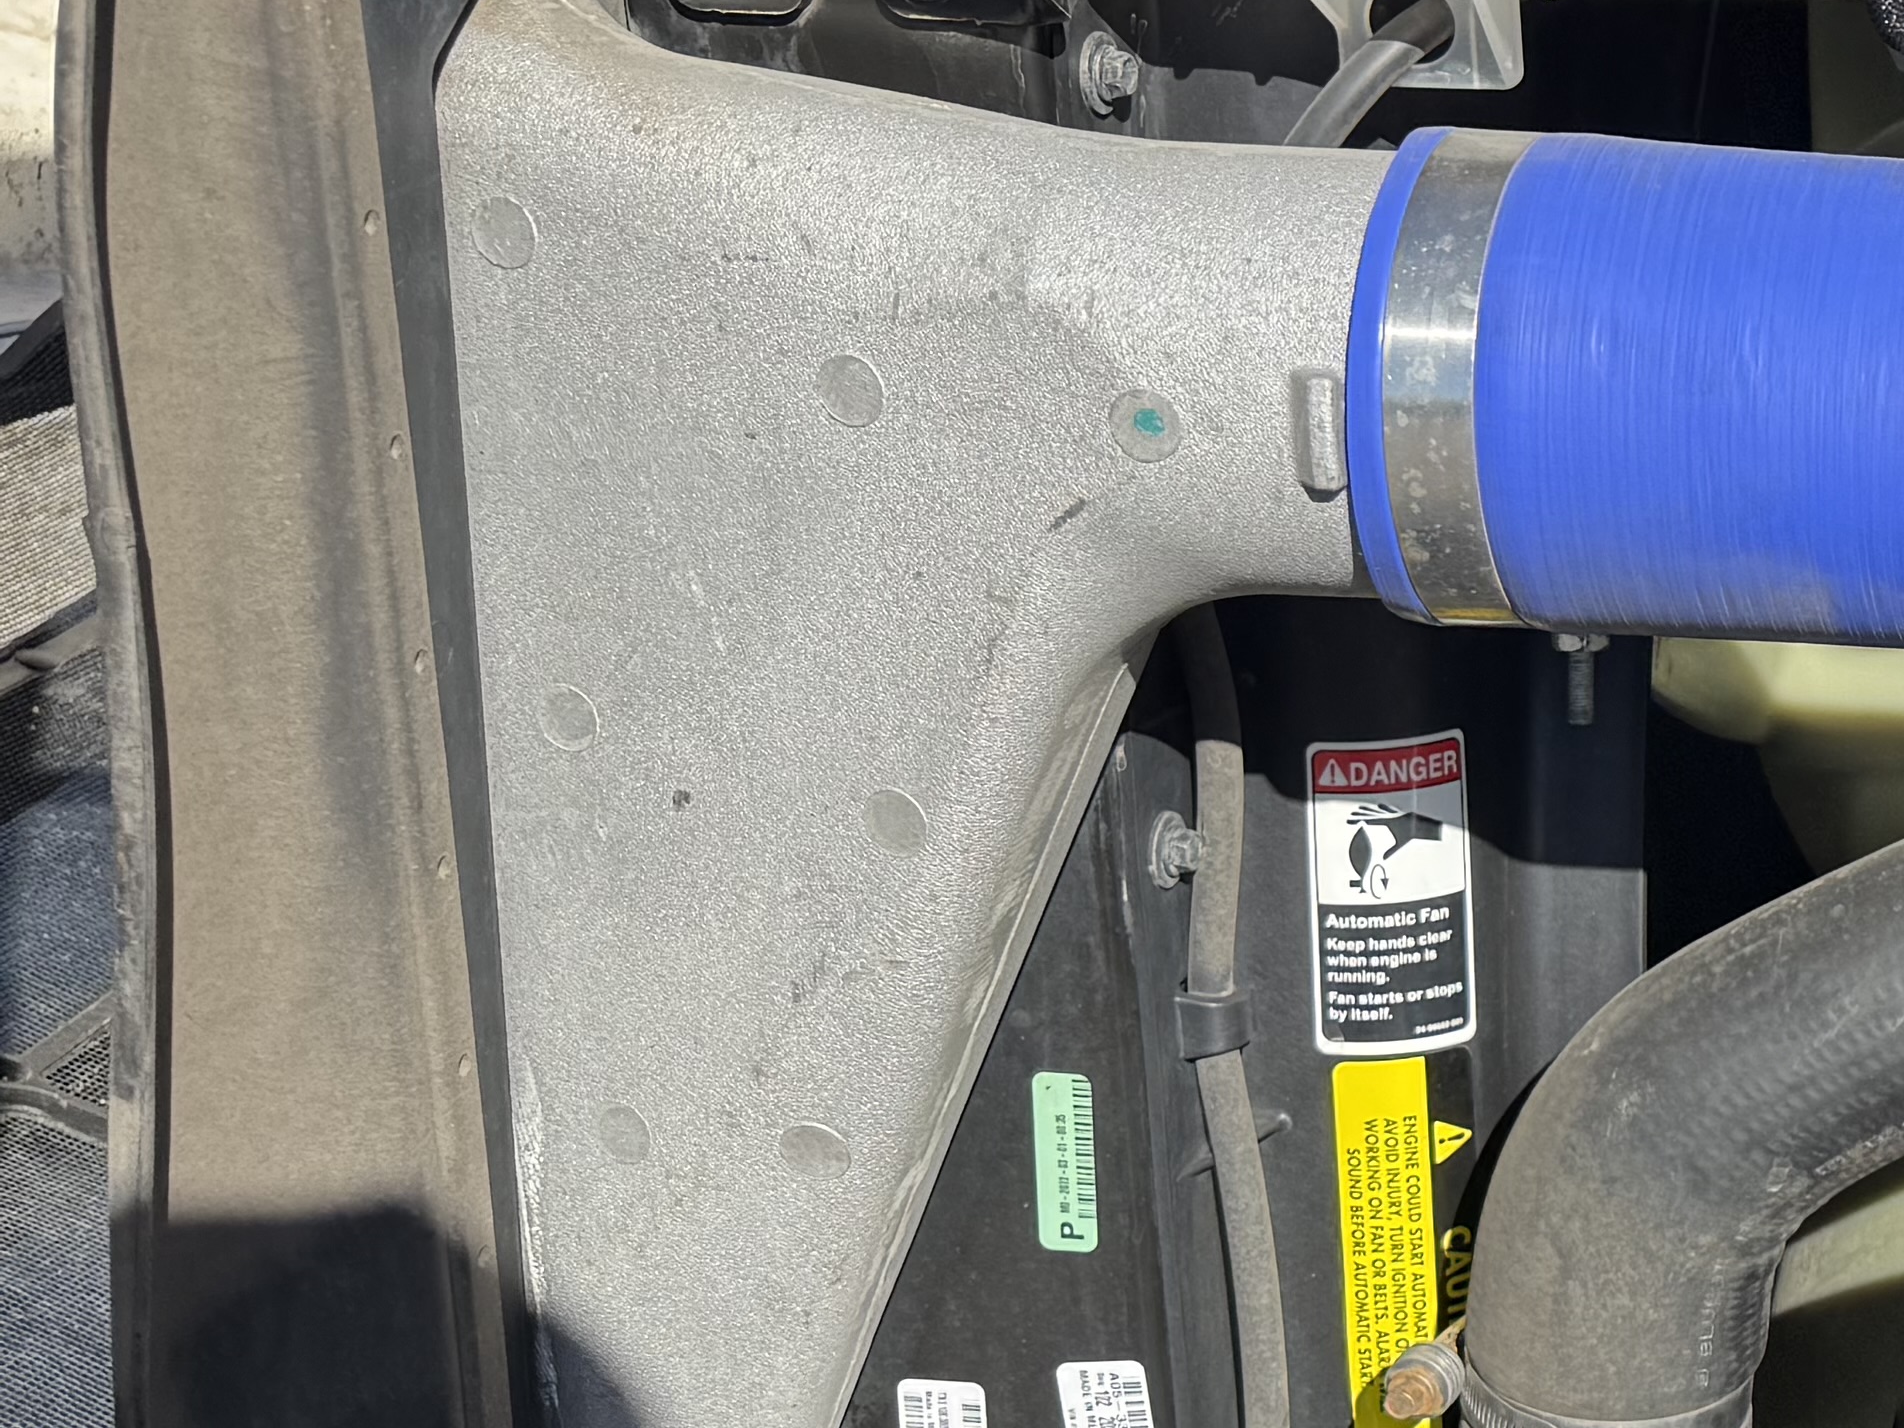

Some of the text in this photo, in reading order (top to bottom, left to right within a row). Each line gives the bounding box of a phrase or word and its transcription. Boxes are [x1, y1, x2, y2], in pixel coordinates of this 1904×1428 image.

[1351, 749, 1458, 787] DANGER
[1326, 906, 1450, 930] Automatic Fan
[1327, 928, 1453, 955] Keep hands clear
[1327, 947, 1438, 971] when engine is
[1327, 969, 1391, 987] running.
[1329, 980, 1463, 1007] Fan starts or stops
[1329, 1006, 1394, 1023] by itself.
[1347, 1147, 1364, 1200] SOUND
[1059, 1221, 1085, 1240] P
[1350, 1205, 1367, 1257] BEFORE
[1364, 1119, 1389, 1324] WORKING ON FAN OR BELTS.
[1383, 1118, 1409, 1335] AVOID INJURY, TURN IGNITION
[1402, 1115, 1429, 1338] ENGINE COULD START AUTOMAT
[1352, 1261, 1372, 1343] AUTOMATIC
[1079, 1370, 1091, 1397] MADE
